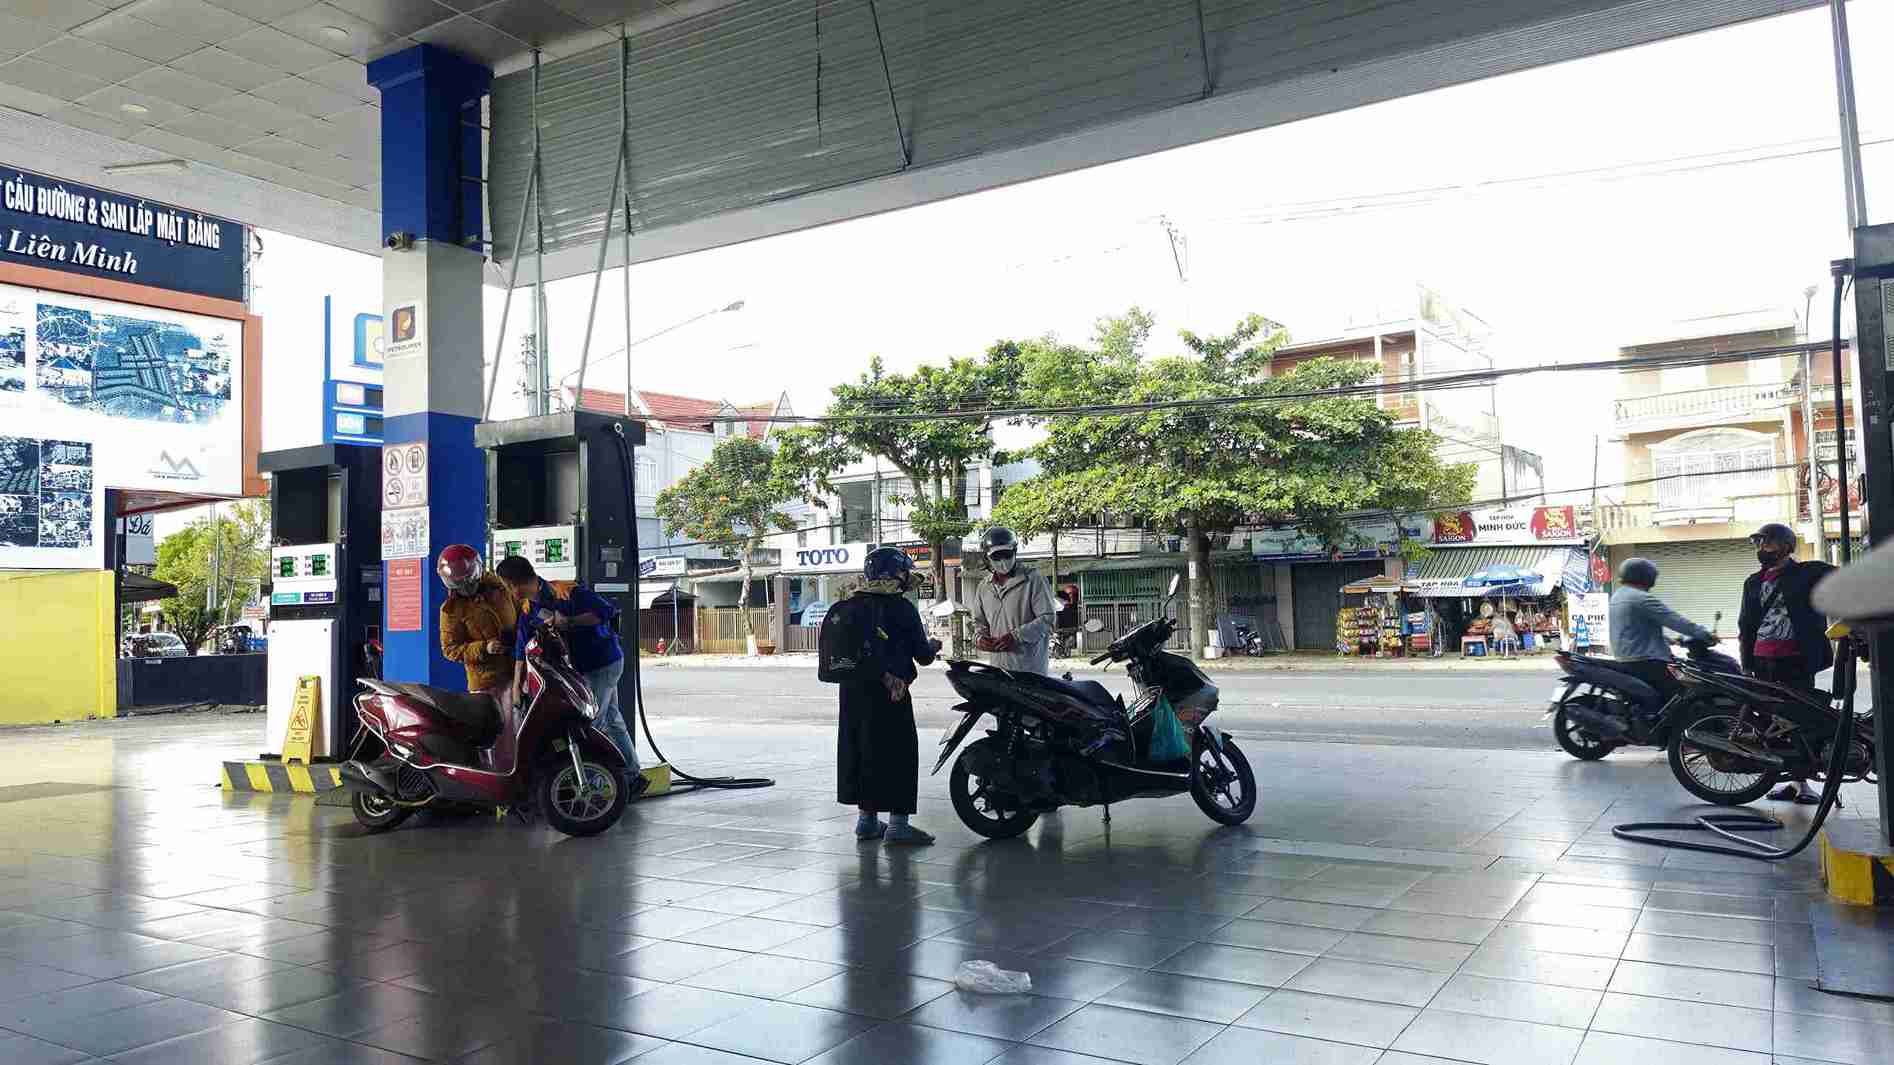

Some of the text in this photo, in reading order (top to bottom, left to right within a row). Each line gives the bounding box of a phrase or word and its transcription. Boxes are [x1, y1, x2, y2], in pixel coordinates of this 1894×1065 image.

[5, 174, 34, 213] CẦU
[37, 185, 85, 222] ĐƯỜNG
[87, 198, 98, 225] &
[101, 201, 127, 230] SAN
[156, 209, 183, 246] MẶT
[7, 229, 66, 261] Liên
[71, 241, 137, 274] Minh
[1478, 523, 1504, 532] MINH
[797, 548, 849, 566] TOTO
